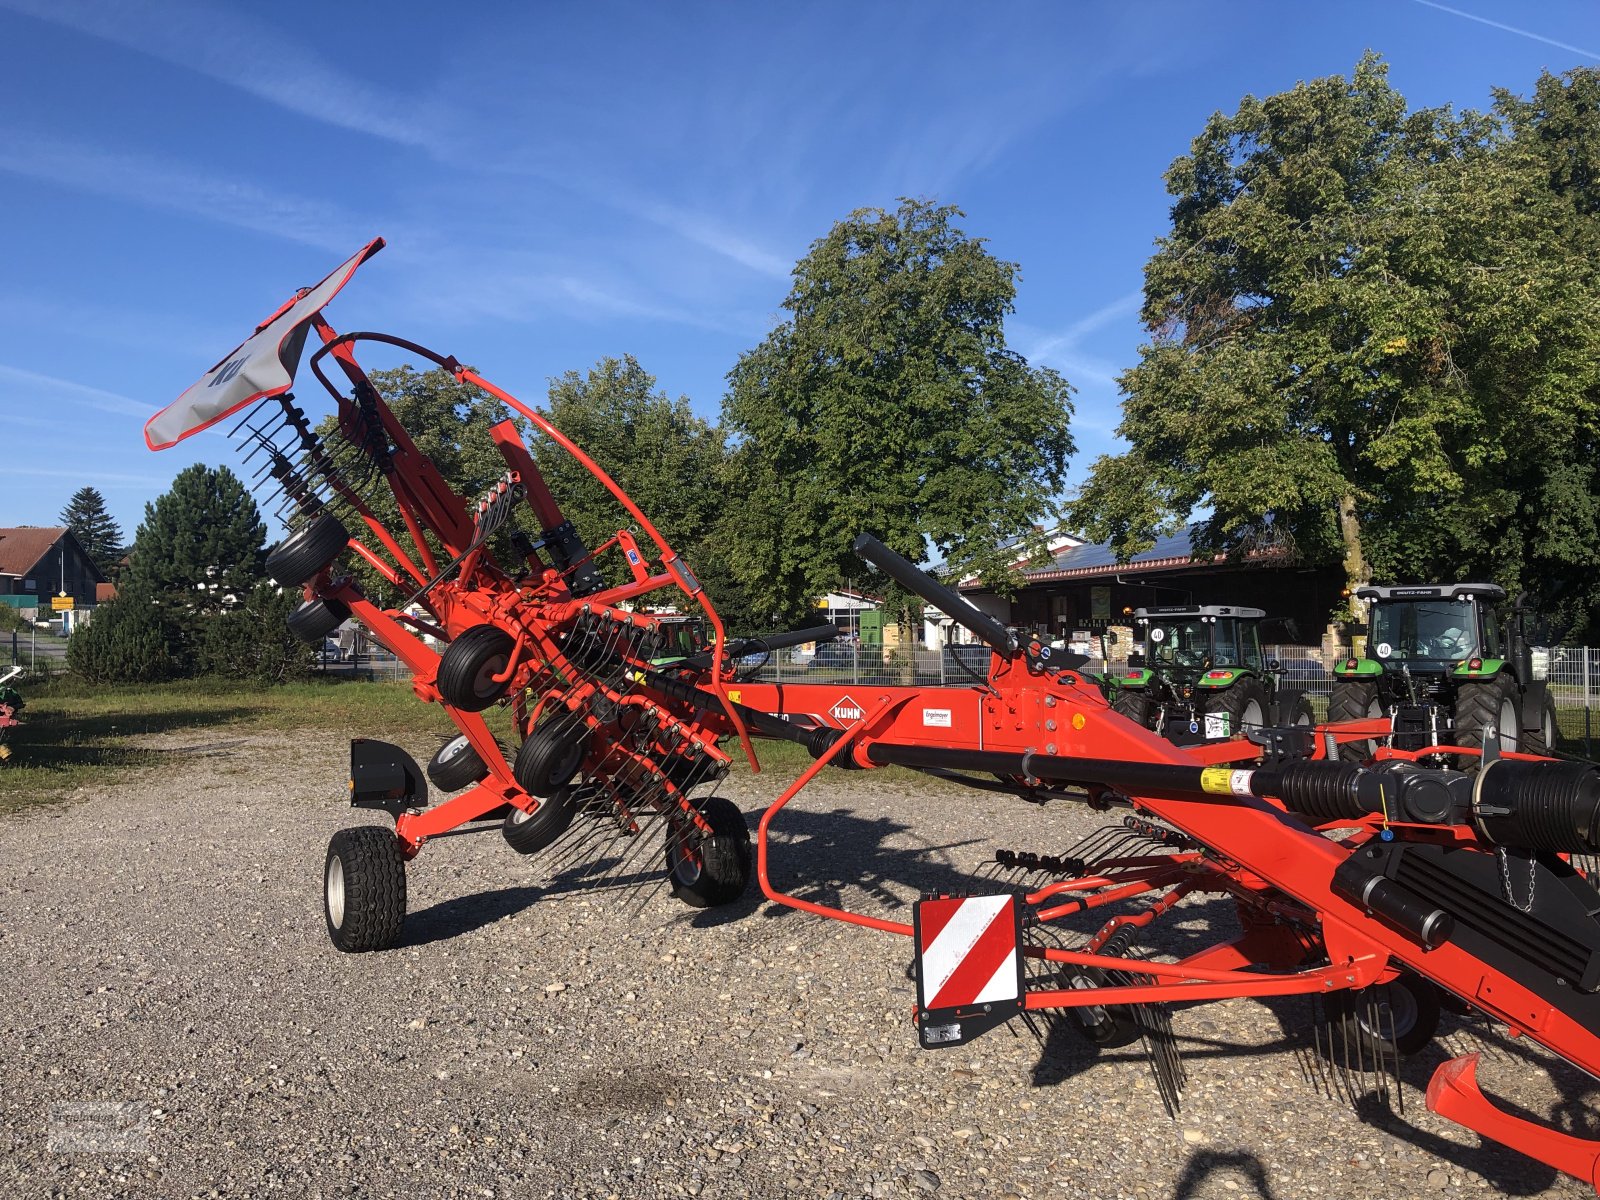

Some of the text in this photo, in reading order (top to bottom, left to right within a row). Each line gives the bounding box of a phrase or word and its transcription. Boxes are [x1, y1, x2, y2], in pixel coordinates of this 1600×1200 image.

[1153, 632, 1162, 640] 40
[1379, 645, 1389, 655] 40
[834, 707, 860, 719] KUHN
